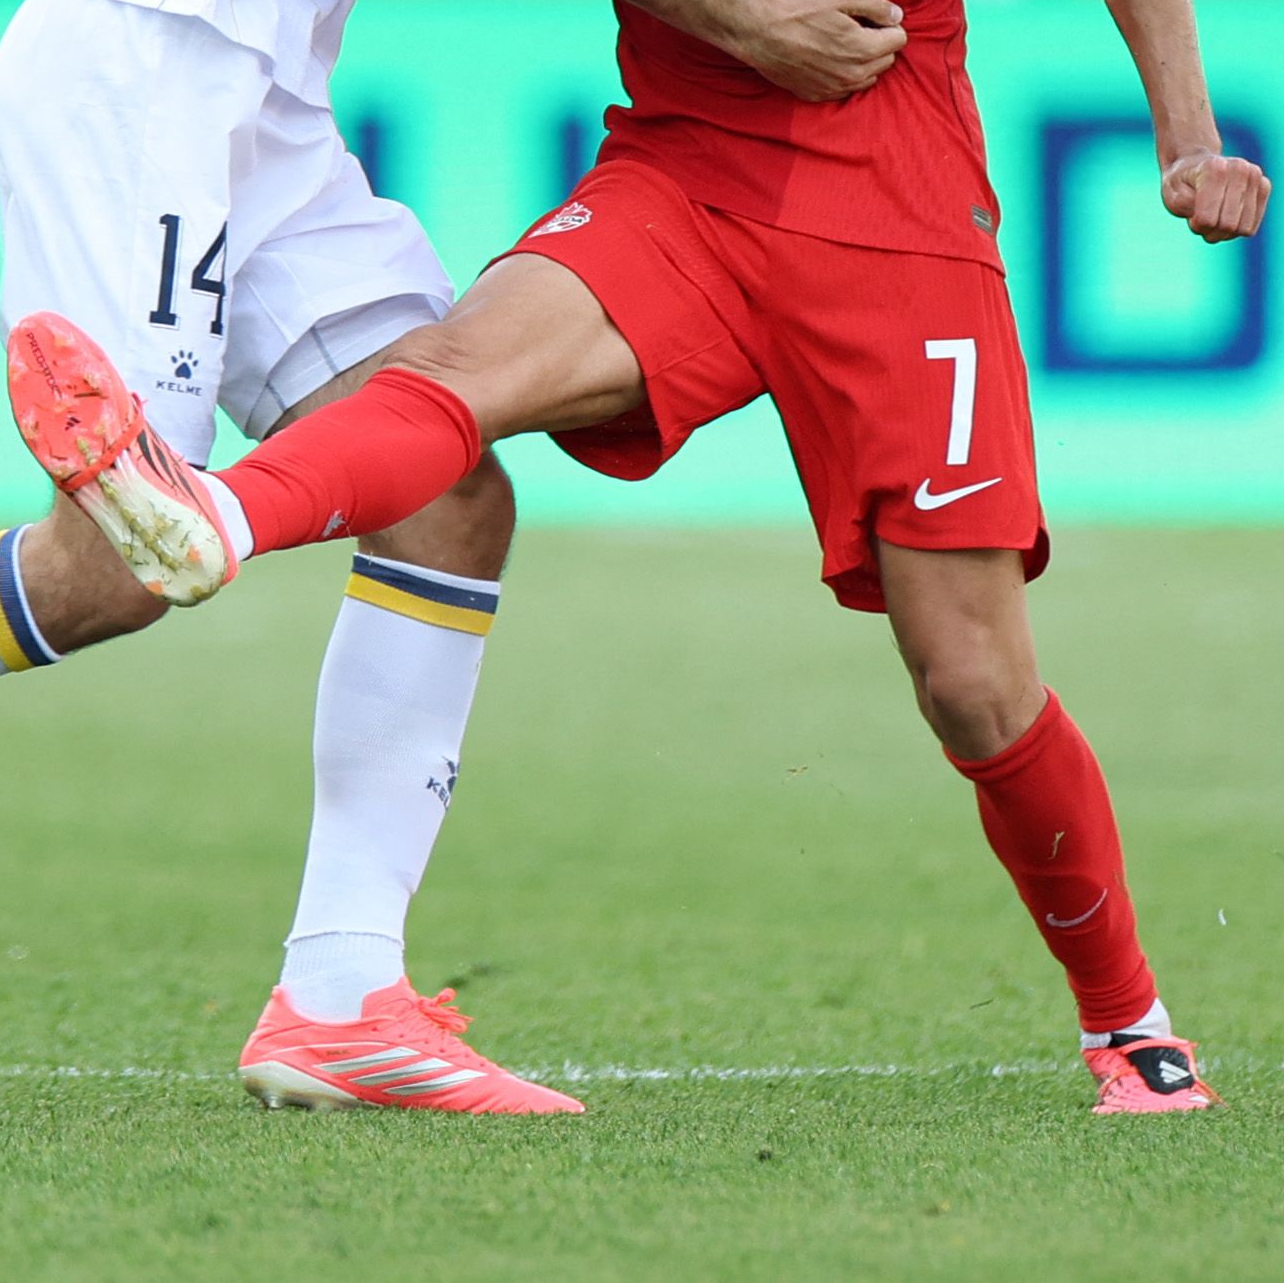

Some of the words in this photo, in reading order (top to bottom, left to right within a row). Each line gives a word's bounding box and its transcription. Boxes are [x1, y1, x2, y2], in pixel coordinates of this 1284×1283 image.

[149, 213, 228, 336] 14
[155, 379, 204, 397] KELME
[924, 337, 977, 466] 7
[426, 777, 449, 812] KEL
